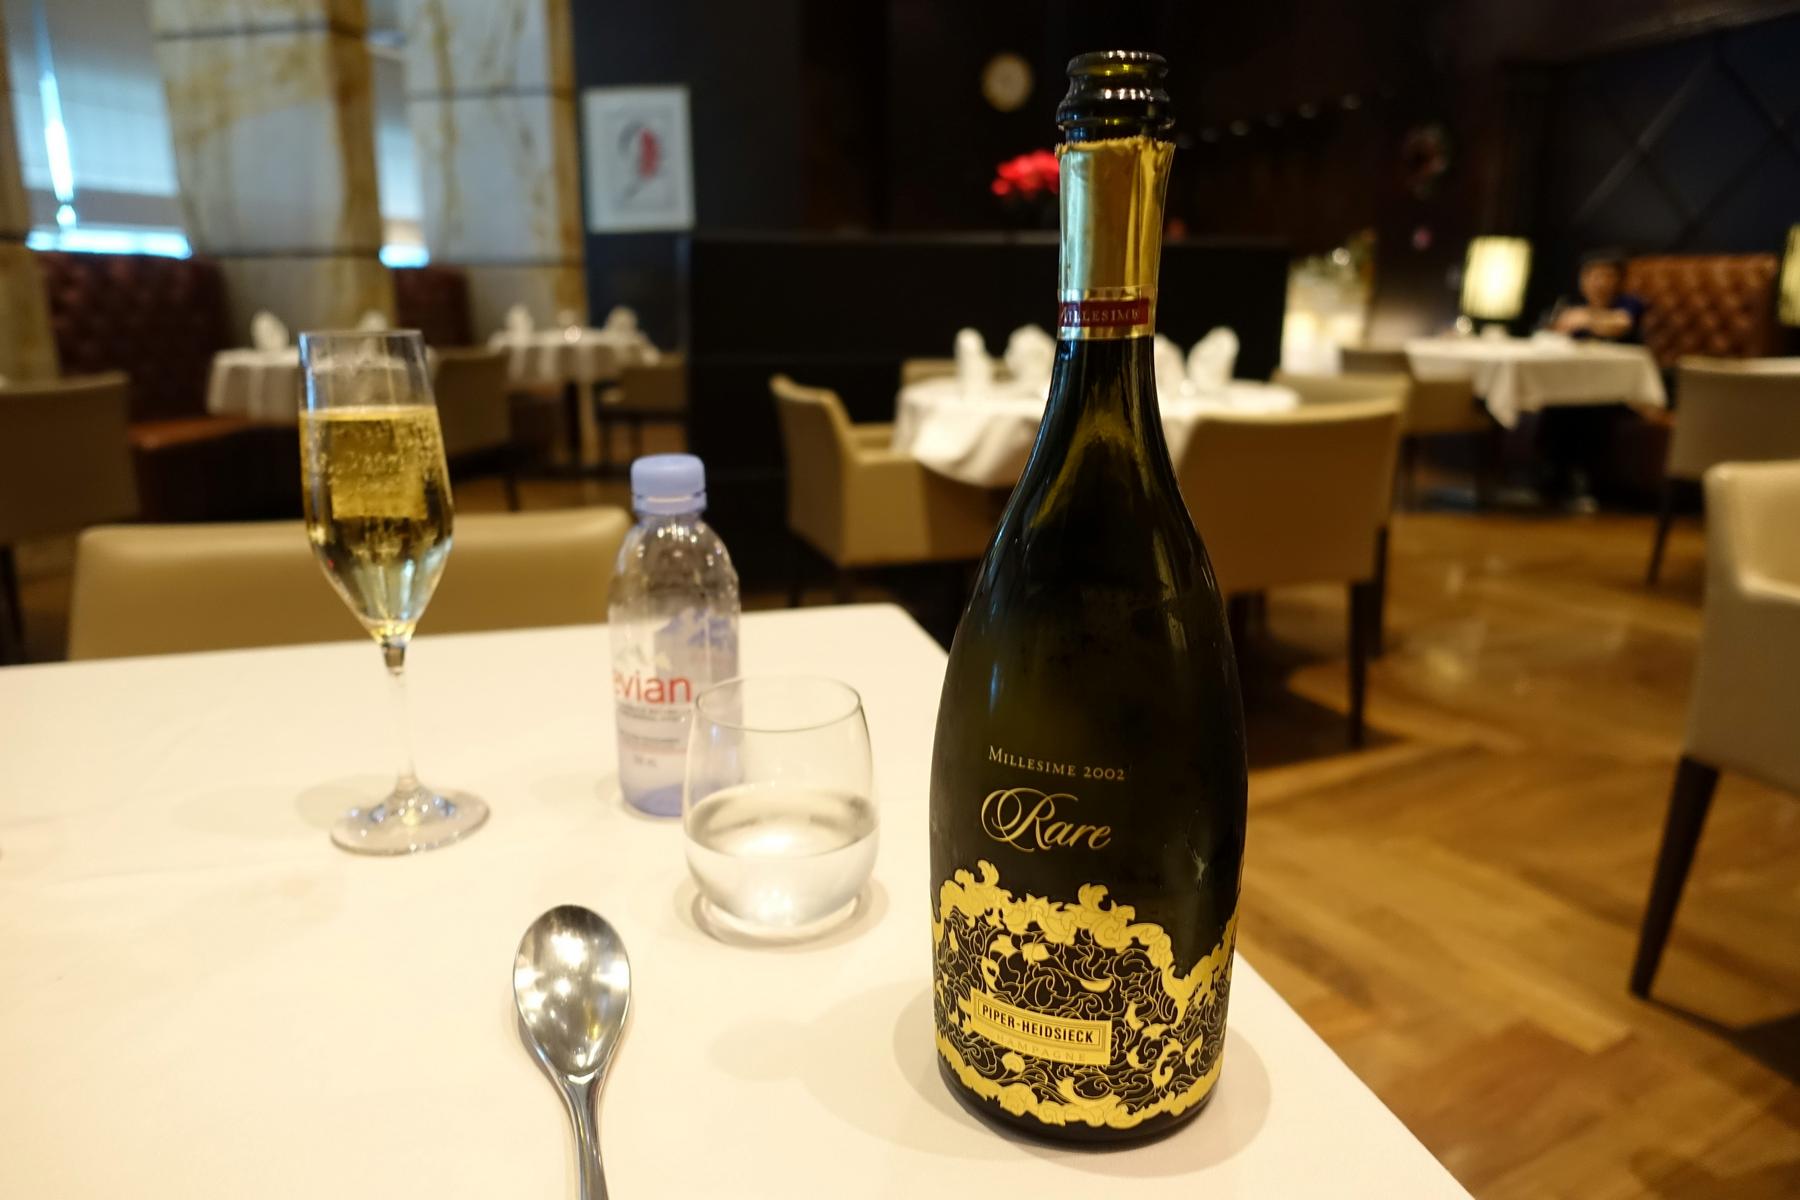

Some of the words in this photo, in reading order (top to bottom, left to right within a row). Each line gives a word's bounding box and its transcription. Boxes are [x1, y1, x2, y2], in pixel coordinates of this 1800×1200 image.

[988, 745, 1076, 777] MILLESIME
[1083, 765, 1125, 781] 2002
[981, 787, 1111, 852] Rare
[982, 1004, 1094, 1043] PIPER-HEIDSIECK
[989, 1032, 1087, 1062] HAMPAGNE
